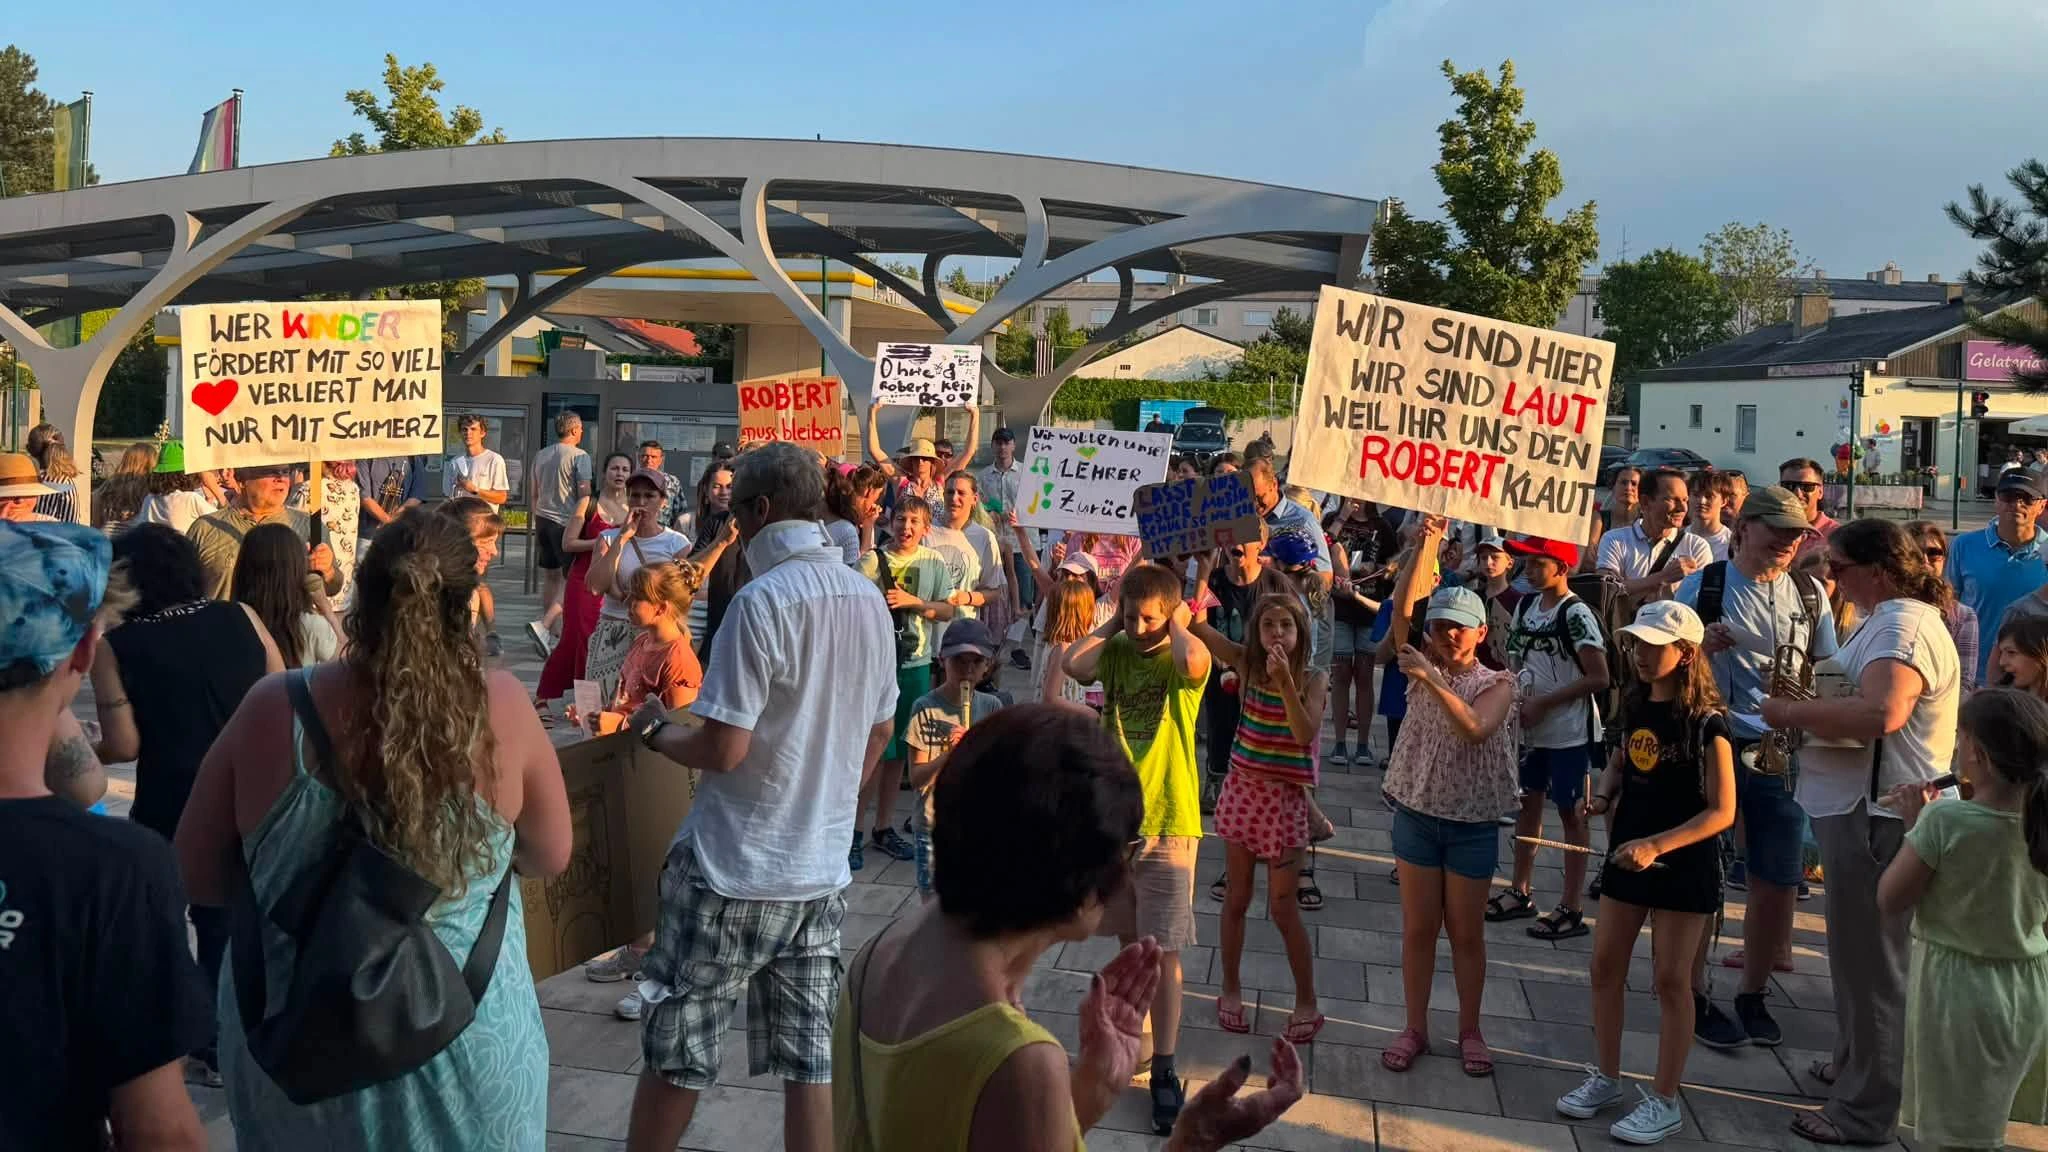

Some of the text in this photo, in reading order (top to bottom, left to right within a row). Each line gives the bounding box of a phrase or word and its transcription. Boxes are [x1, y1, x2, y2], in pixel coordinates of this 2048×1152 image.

[210, 309, 401, 342] WER KINDER
[1336, 299, 1603, 389] WIR SIND HIER
[193, 348, 300, 379] FÖRDERT
[356, 350, 385, 371] SO
[392, 347, 441, 373] VIEL
[248, 376, 427, 405] VERLIERT MAN
[740, 381, 837, 412] ROBERT
[1350, 358, 1597, 434] WIR SIND LAUT
[205, 411, 440, 447] NUR MIT SCHMERZ
[741, 416, 843, 441] muss bleiben
[1323, 395, 1592, 470] WEIL IHR UNS DEN
[1060, 458, 1142, 482] LEHRER
[1359, 435, 1597, 516] ROBERT KLAUT
